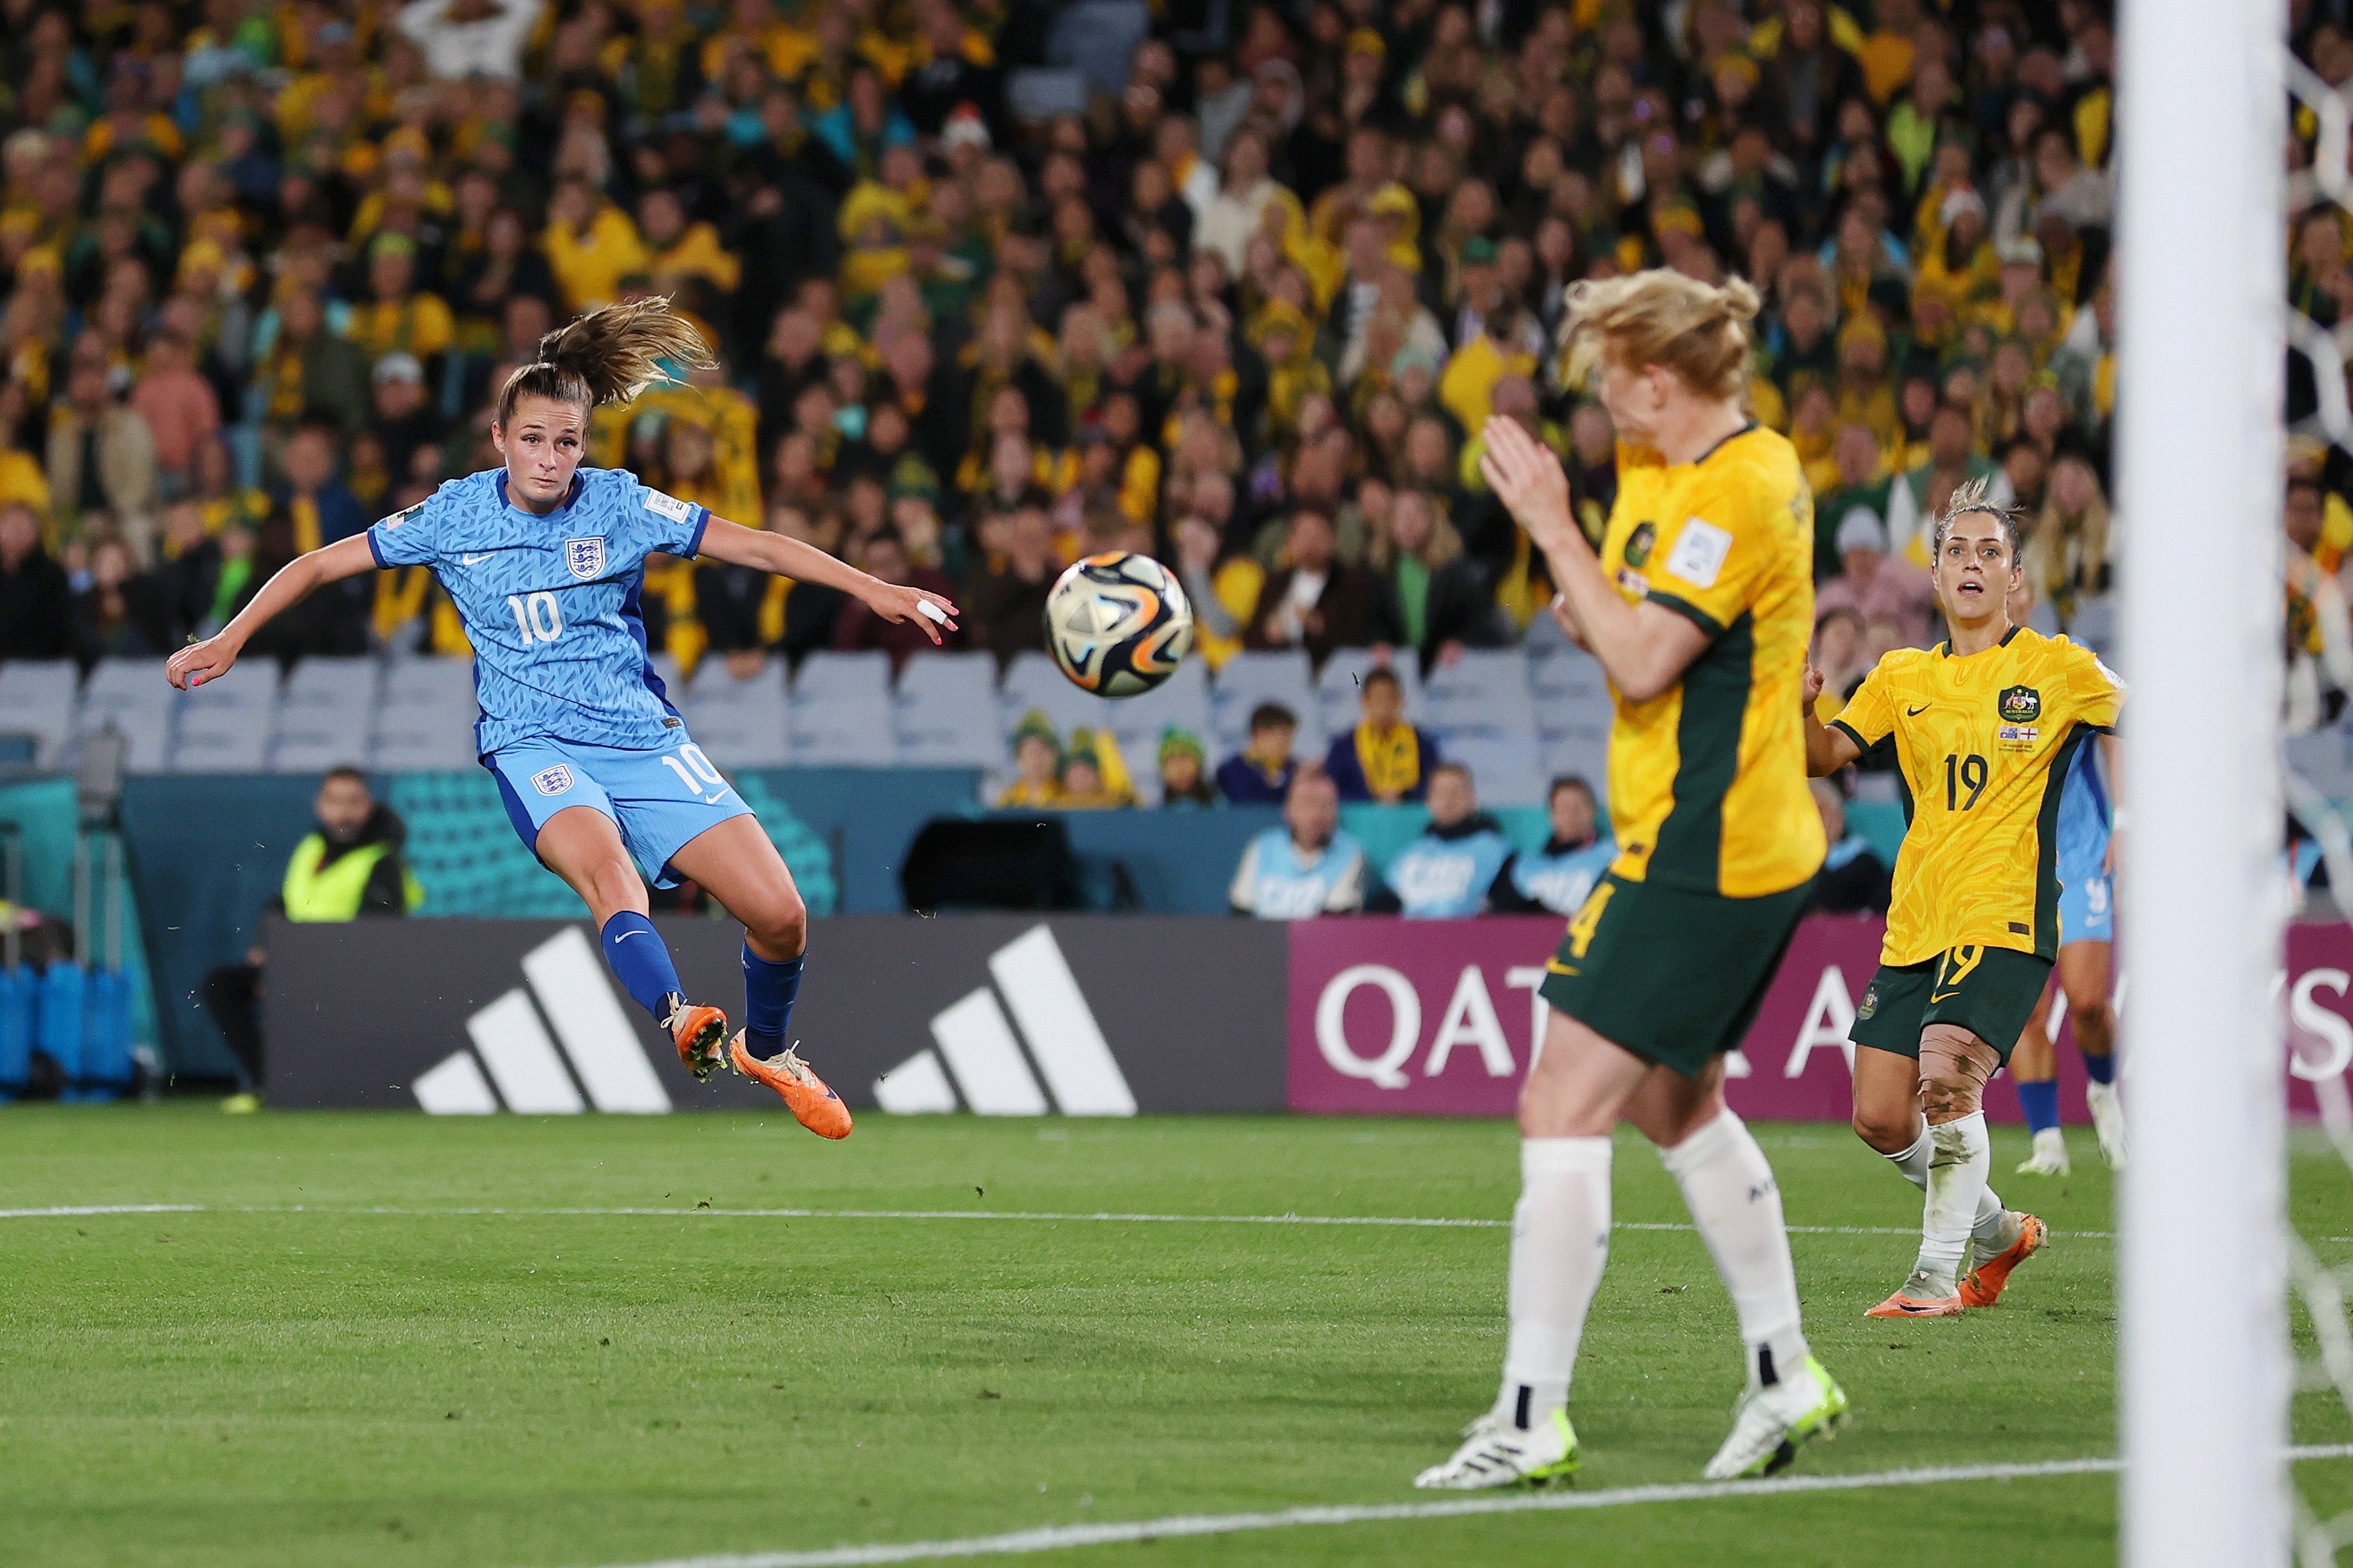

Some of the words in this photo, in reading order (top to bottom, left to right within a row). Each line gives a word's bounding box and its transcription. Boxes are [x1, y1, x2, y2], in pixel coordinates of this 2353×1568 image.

[508, 591, 562, 645] 10
[661, 744, 723, 796] 10
[1944, 754, 1988, 811] 19
[1568, 882, 1616, 959] 4
